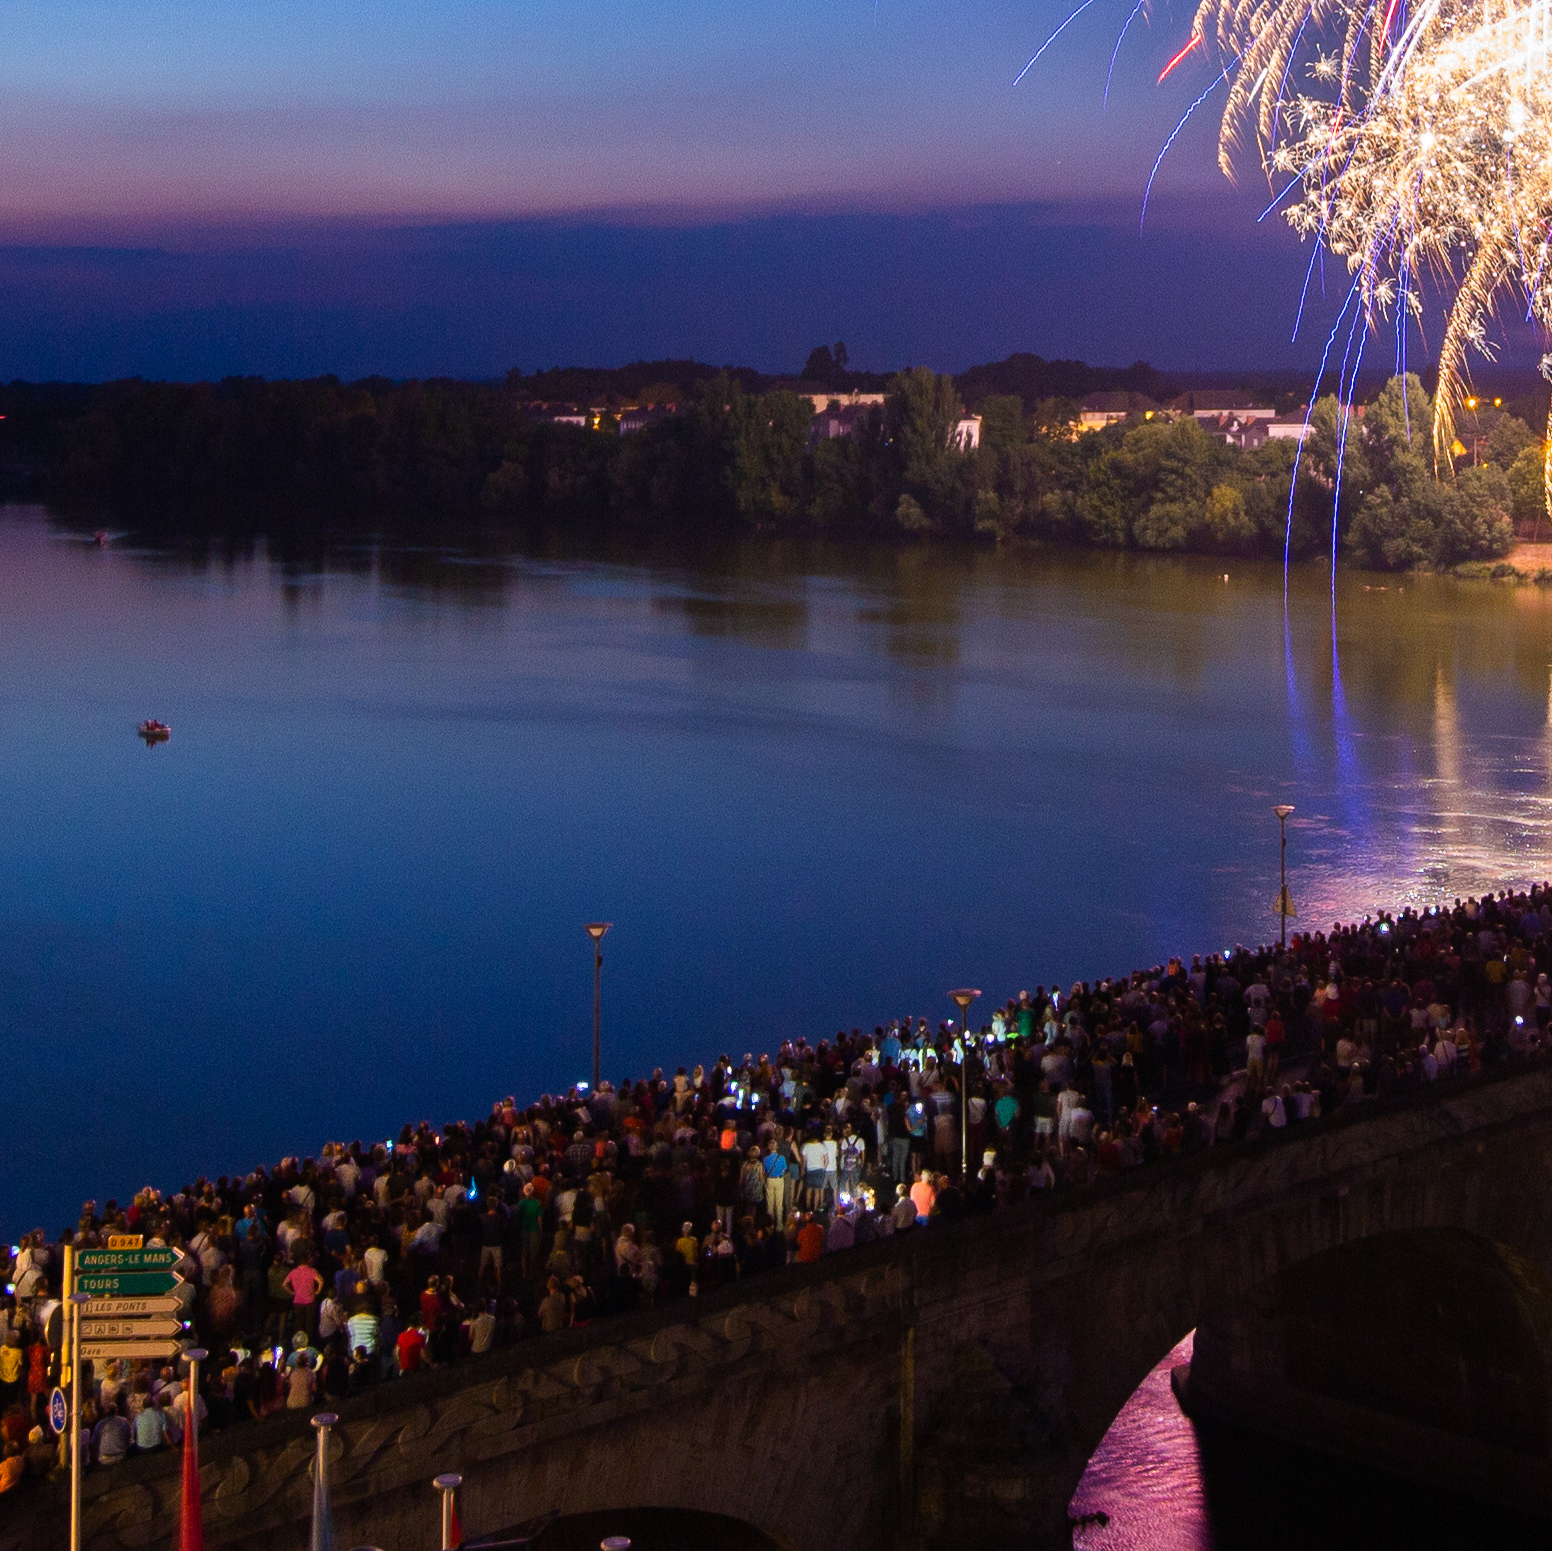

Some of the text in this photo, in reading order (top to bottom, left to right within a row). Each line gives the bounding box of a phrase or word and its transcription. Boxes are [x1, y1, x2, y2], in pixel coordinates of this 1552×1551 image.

[110, 1238, 139, 1247] D 947
[143, 1252, 172, 1263] MANS
[83, 1278, 119, 1289] TOURS
[95, 1301, 147, 1312] LES PONTS
